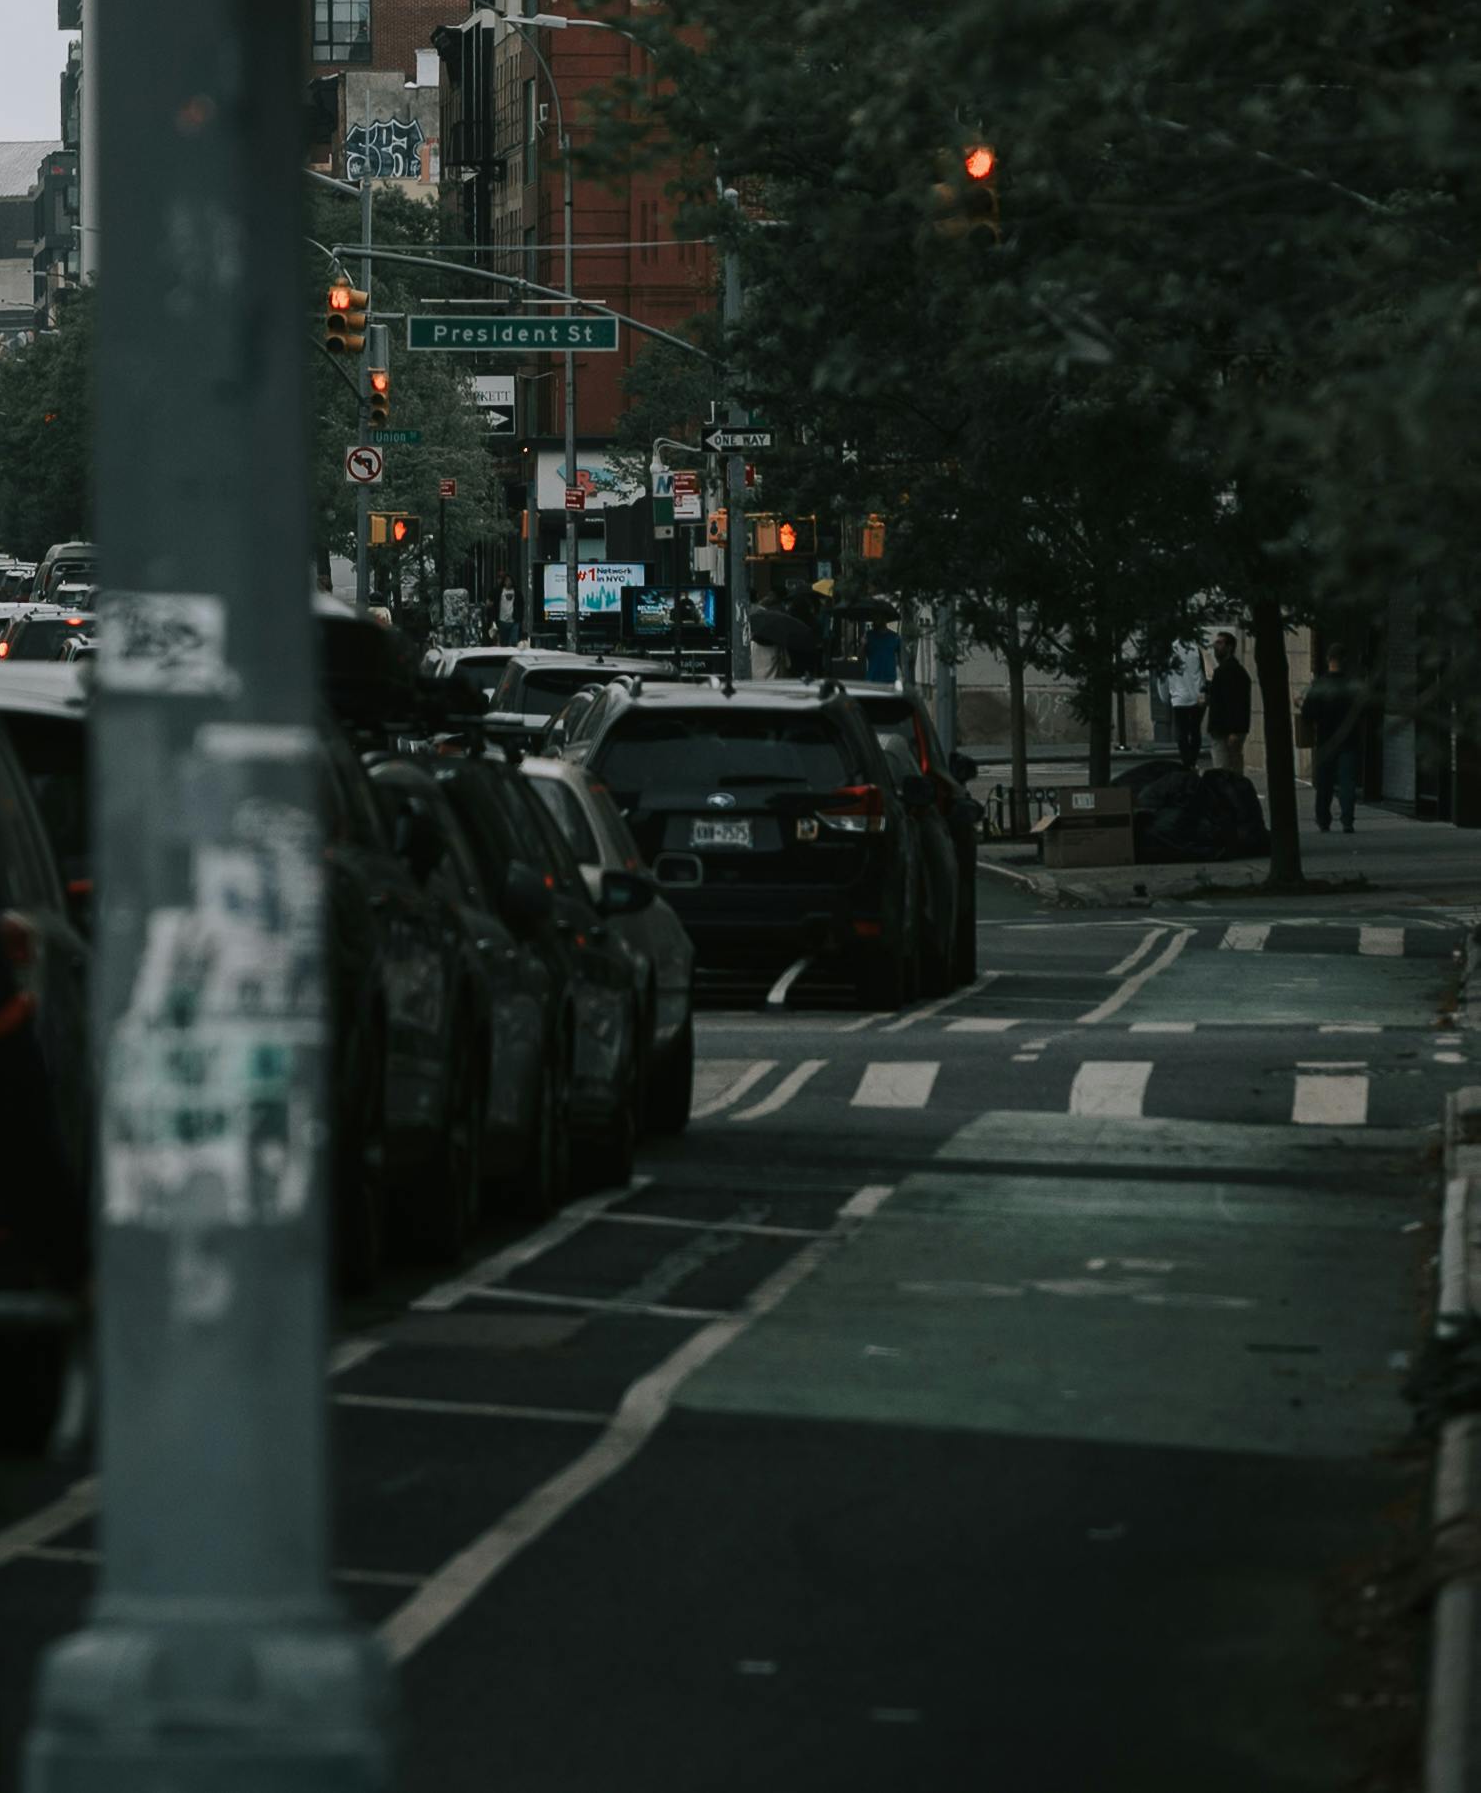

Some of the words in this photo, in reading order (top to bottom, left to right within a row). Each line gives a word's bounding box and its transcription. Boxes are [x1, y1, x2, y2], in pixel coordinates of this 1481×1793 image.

[434, 324, 558, 342] President
[567, 324, 592, 342] St
[375, 431, 406, 443] Union
[714, 434, 736, 446] ONE
[743, 434, 767, 445] WAY
